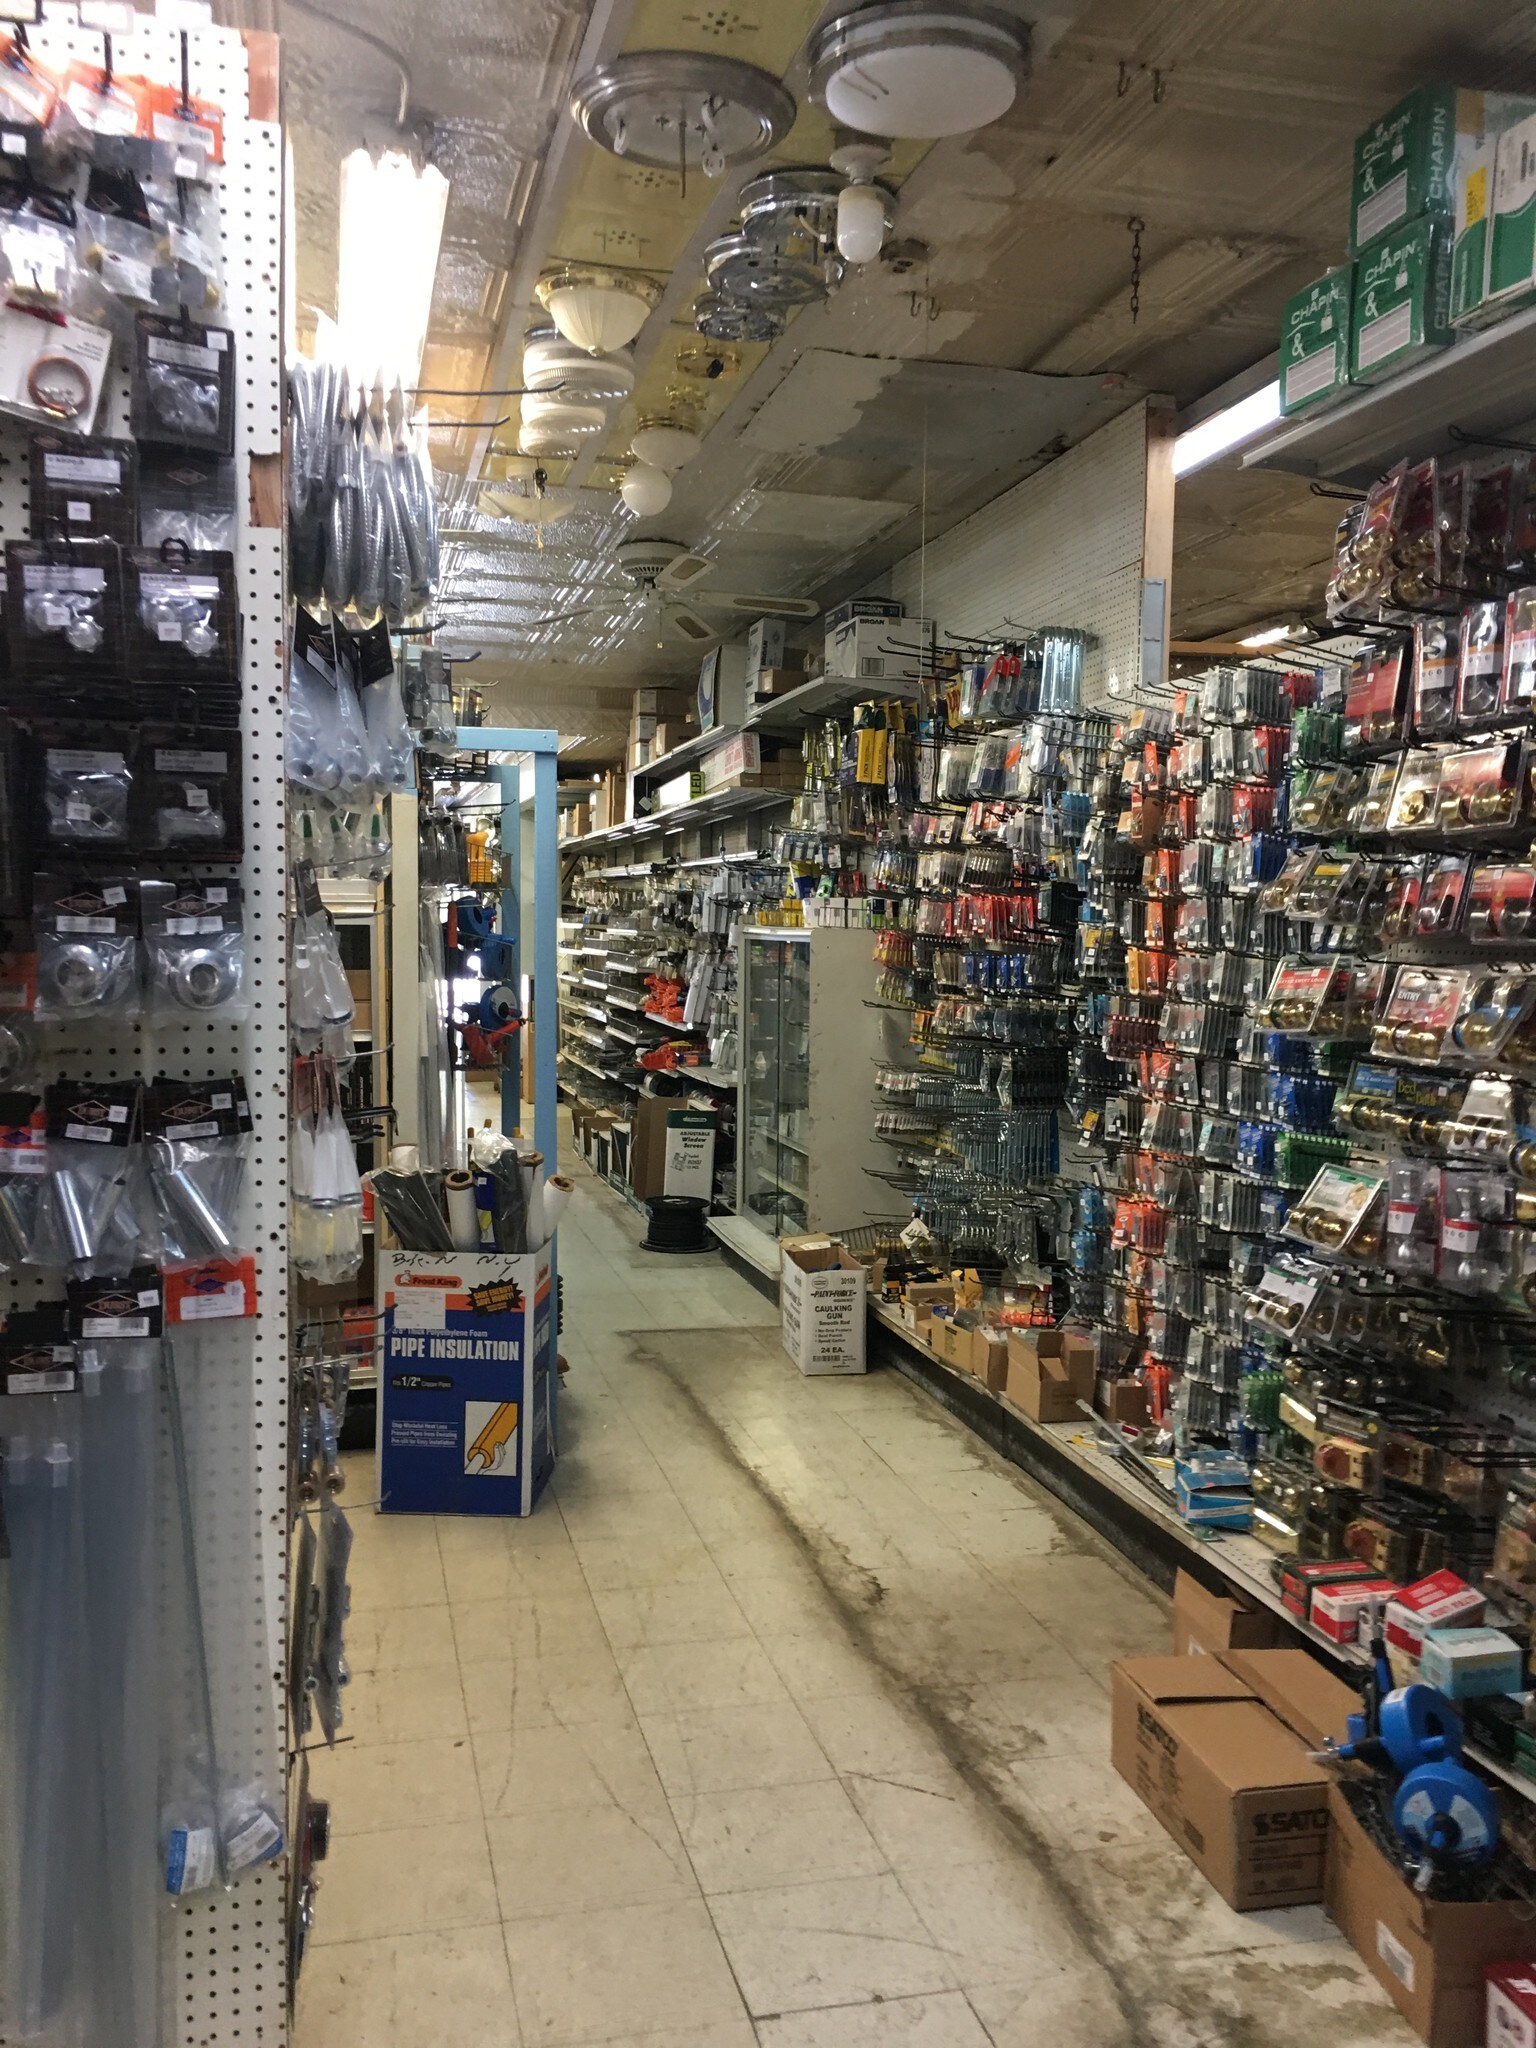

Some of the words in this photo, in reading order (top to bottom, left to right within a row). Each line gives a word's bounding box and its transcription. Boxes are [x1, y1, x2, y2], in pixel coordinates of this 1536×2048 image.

[1430, 107, 1446, 200] CHAPIN
[1365, 239, 1417, 283] CHAPIN
[1291, 283, 1341, 325] CHAPIN
[691, 773, 701, 794] LED
[1397, 991, 1420, 1001] ENTRY
[1398, 1079, 1417, 1094] Bed
[412, 1277, 436, 1286] Frost
[439, 1277, 458, 1288] King
[473, 1289, 489, 1299] SAVE
[475, 1297, 490, 1308] SAVE
[815, 1304, 852, 1312] CAULKING
[426, 1329, 469, 1338] Polyethylene
[391, 1337, 426, 1358] PIPE
[430, 1338, 520, 1360] INSULATION
[401, 1376, 421, 1387] 1/2"
[1271, 1808, 1330, 1834] SATC
